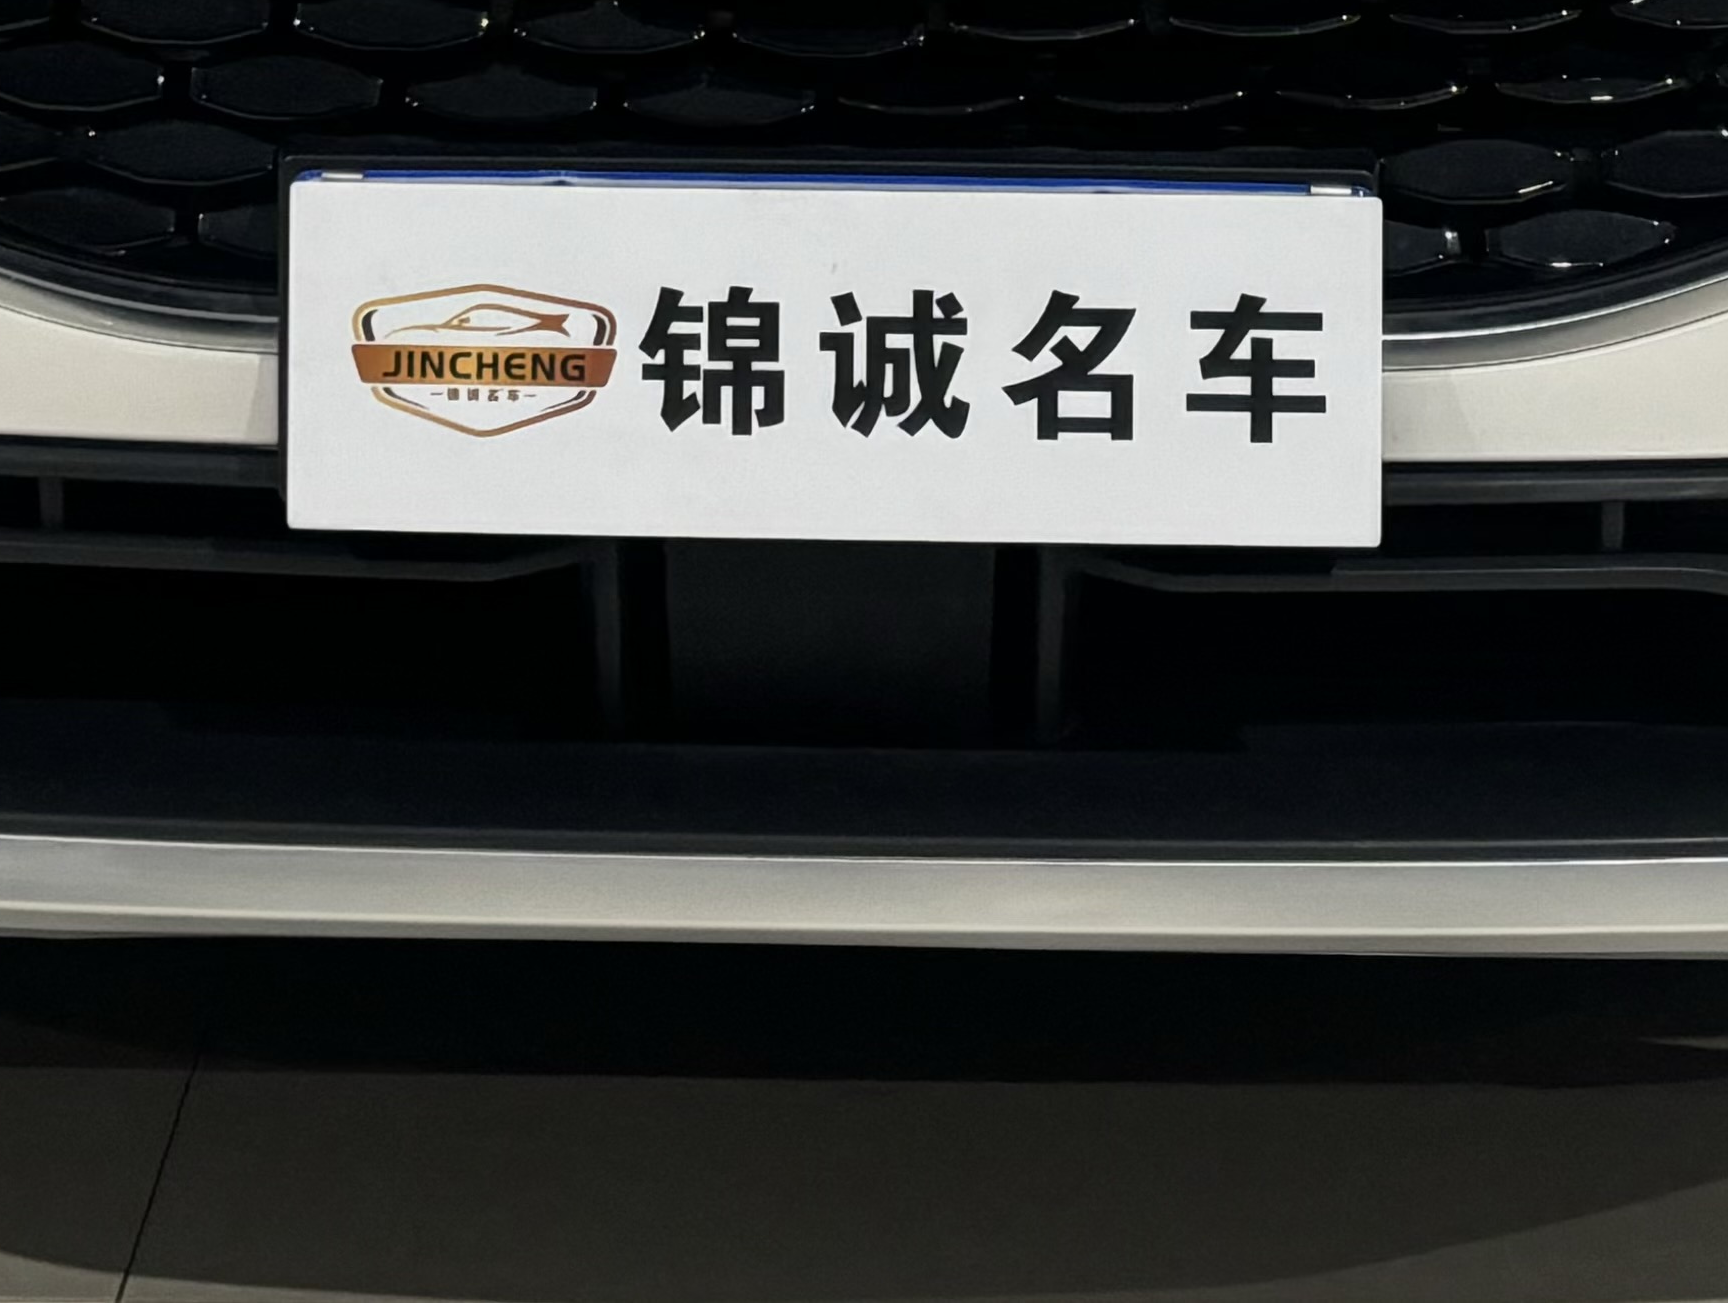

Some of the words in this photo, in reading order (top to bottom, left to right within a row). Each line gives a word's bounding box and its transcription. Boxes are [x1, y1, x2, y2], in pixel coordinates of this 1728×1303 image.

[381, 350, 586, 382] JINCHENG
[639, 286, 1326, 443] 锦诚名车
